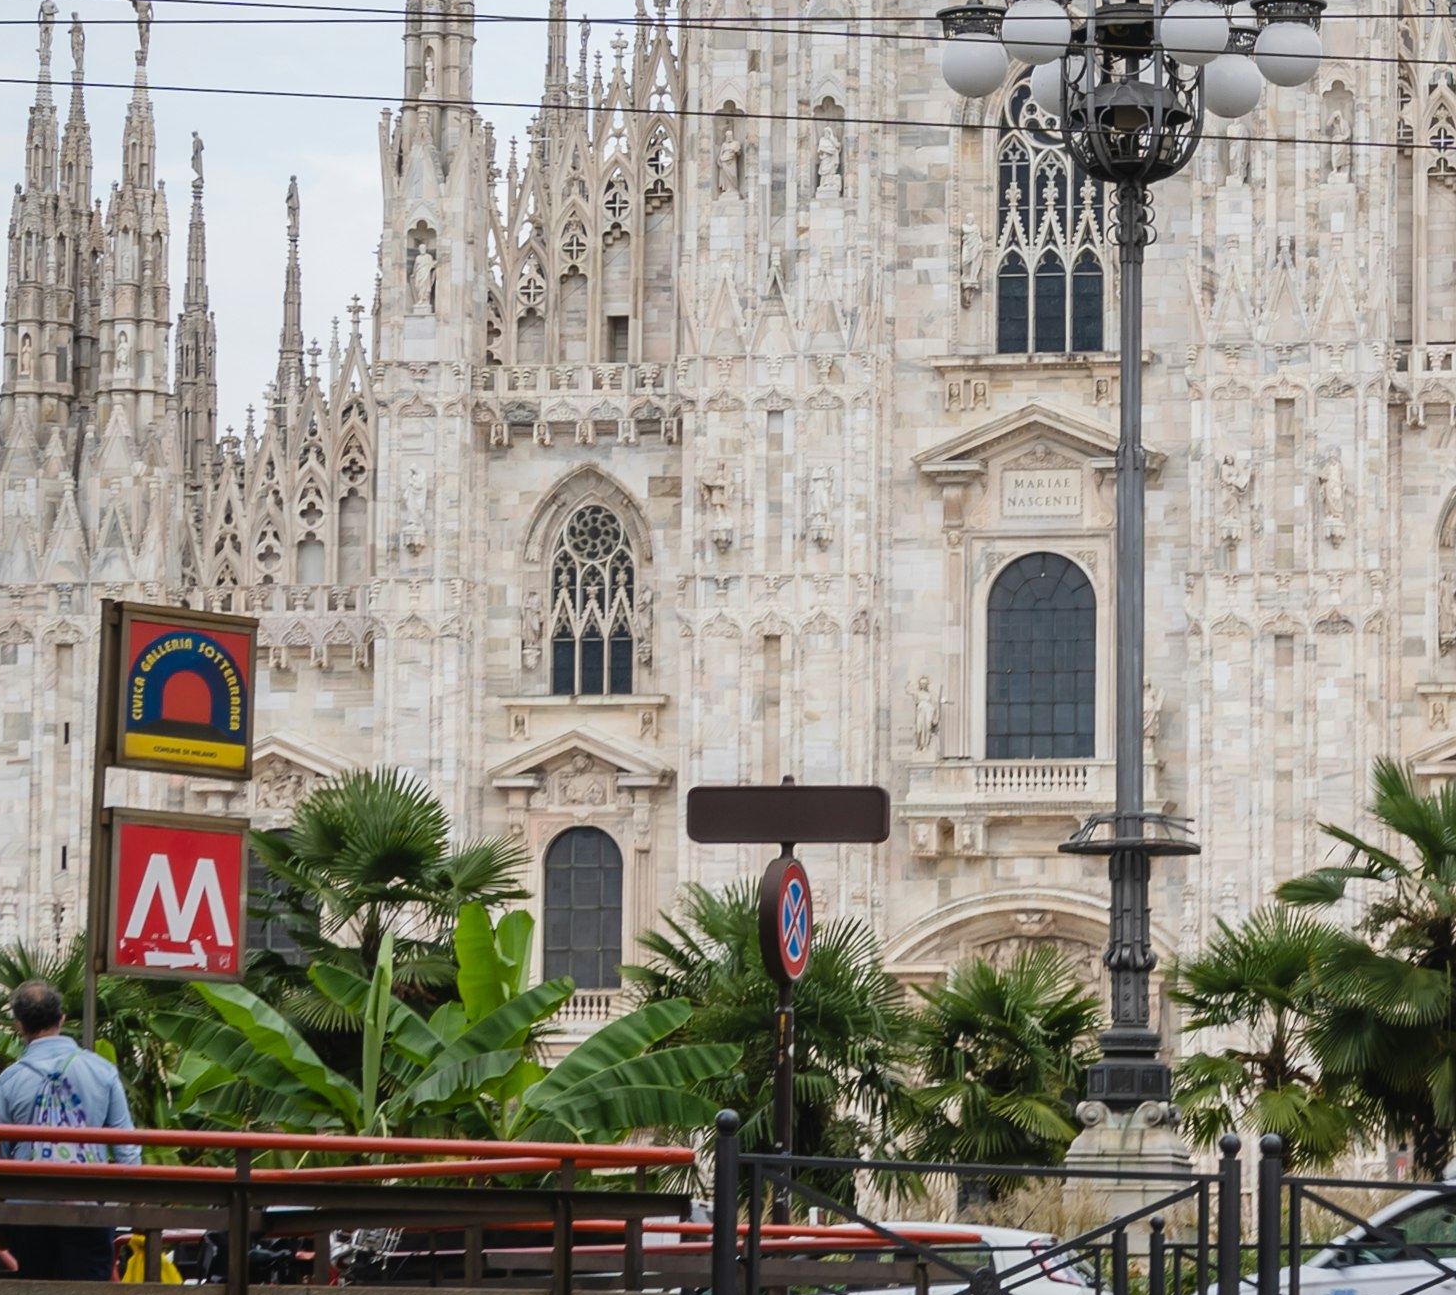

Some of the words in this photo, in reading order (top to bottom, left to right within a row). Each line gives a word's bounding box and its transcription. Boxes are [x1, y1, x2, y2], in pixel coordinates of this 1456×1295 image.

[1014, 478, 1071, 489] MARIAE
[1007, 496, 1078, 507] NASCENTI
[132, 676, 146, 721] CIVICA
[140, 637, 193, 672] GALLERIA
[197, 642, 241, 731] SOTTERRANEA
[153, 745, 181, 754] COMUNE
[191, 750, 218, 759] MILANO
[124, 853, 234, 947] M
